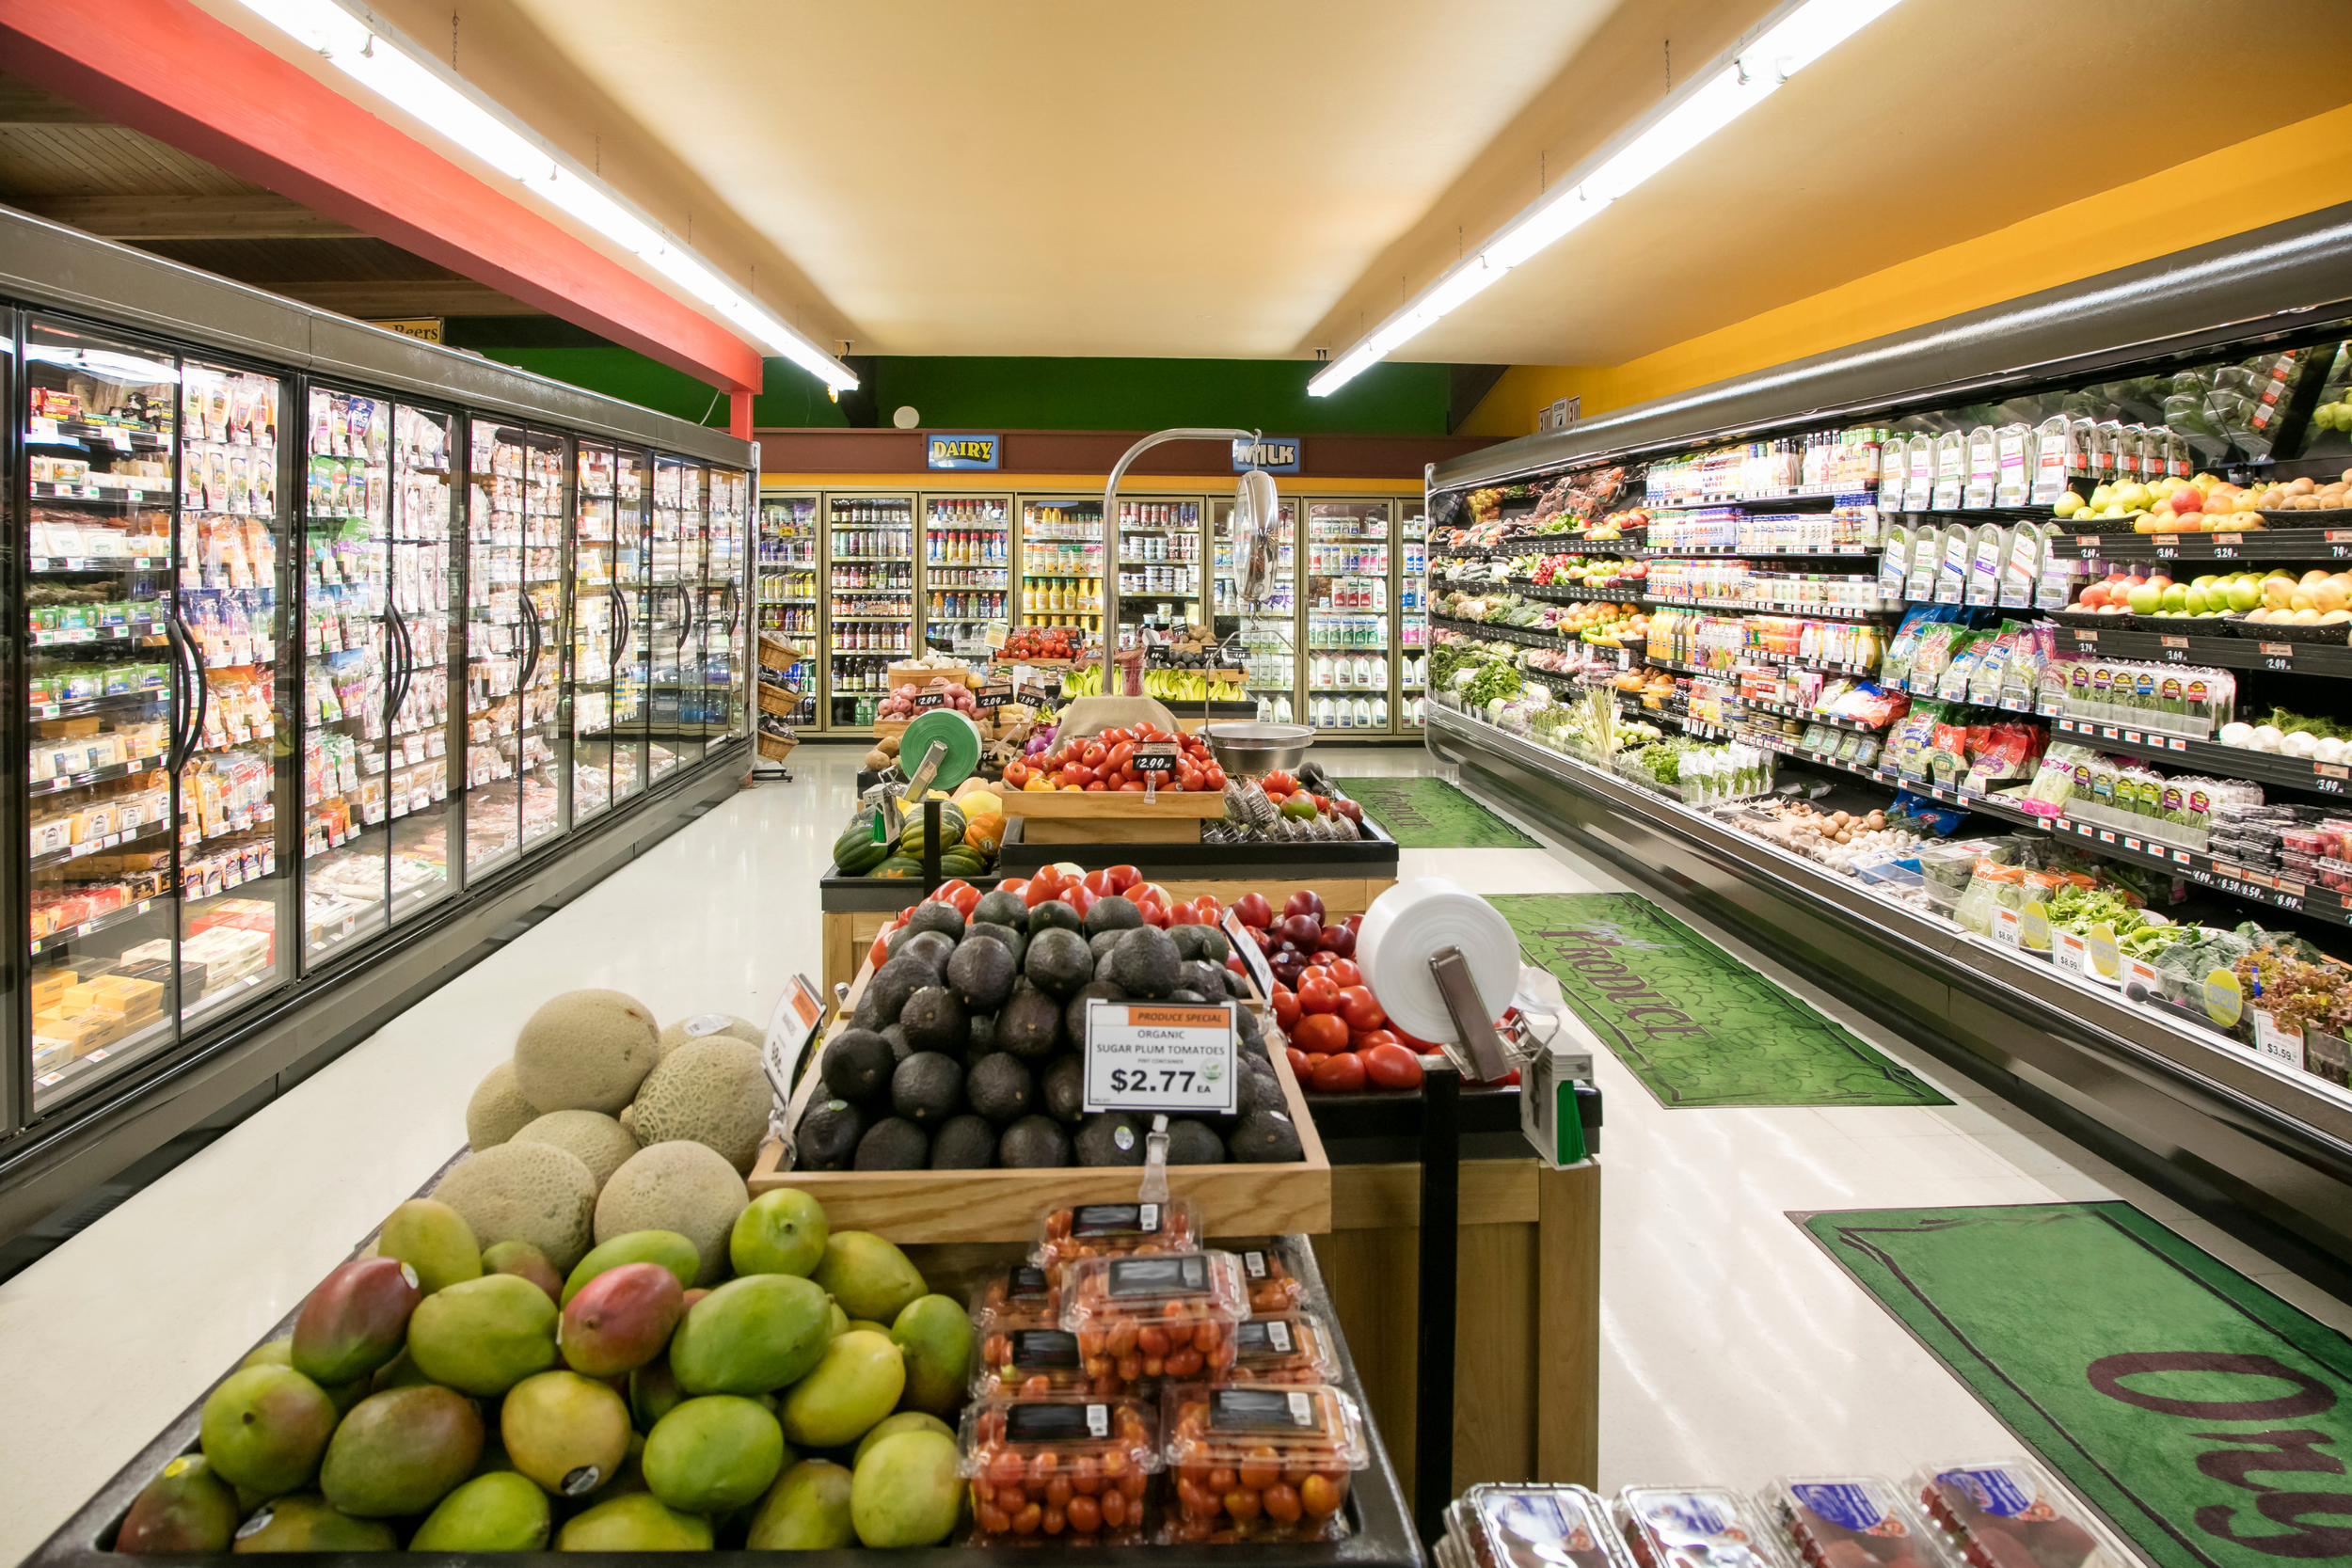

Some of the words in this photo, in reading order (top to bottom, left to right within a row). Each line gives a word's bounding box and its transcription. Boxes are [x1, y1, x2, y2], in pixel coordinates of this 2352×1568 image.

[932, 441, 993, 461] DAIRY
[1237, 444, 1295, 466] MILK
[1998, 930, 2013, 942] $8.99
[2025, 920, 2046, 937] LOCAL
[2091, 943, 2118, 962] LOCAL
[2060, 956, 2077, 970] $8.99
[1536, 929, 1716, 1041] PRODUCE
[2206, 982, 2240, 1001] GROWN
[2206, 991, 2239, 1013] LOCAL
[1137, 1012, 1183, 1022] PRODUCE
[1185, 1013, 1221, 1023] SPECIAL
[1137, 1030, 1185, 1039] ORGANIC
[1096, 1044, 1132, 1053] SUGAR
[1135, 1045, 1165, 1054] PLUM
[1168, 1046, 1225, 1055] TOMATOES
[2266, 1043, 2292, 1061] $3.59
[1110, 1069, 1196, 1094] $2.77
[1197, 1085, 1212, 1094] EA
